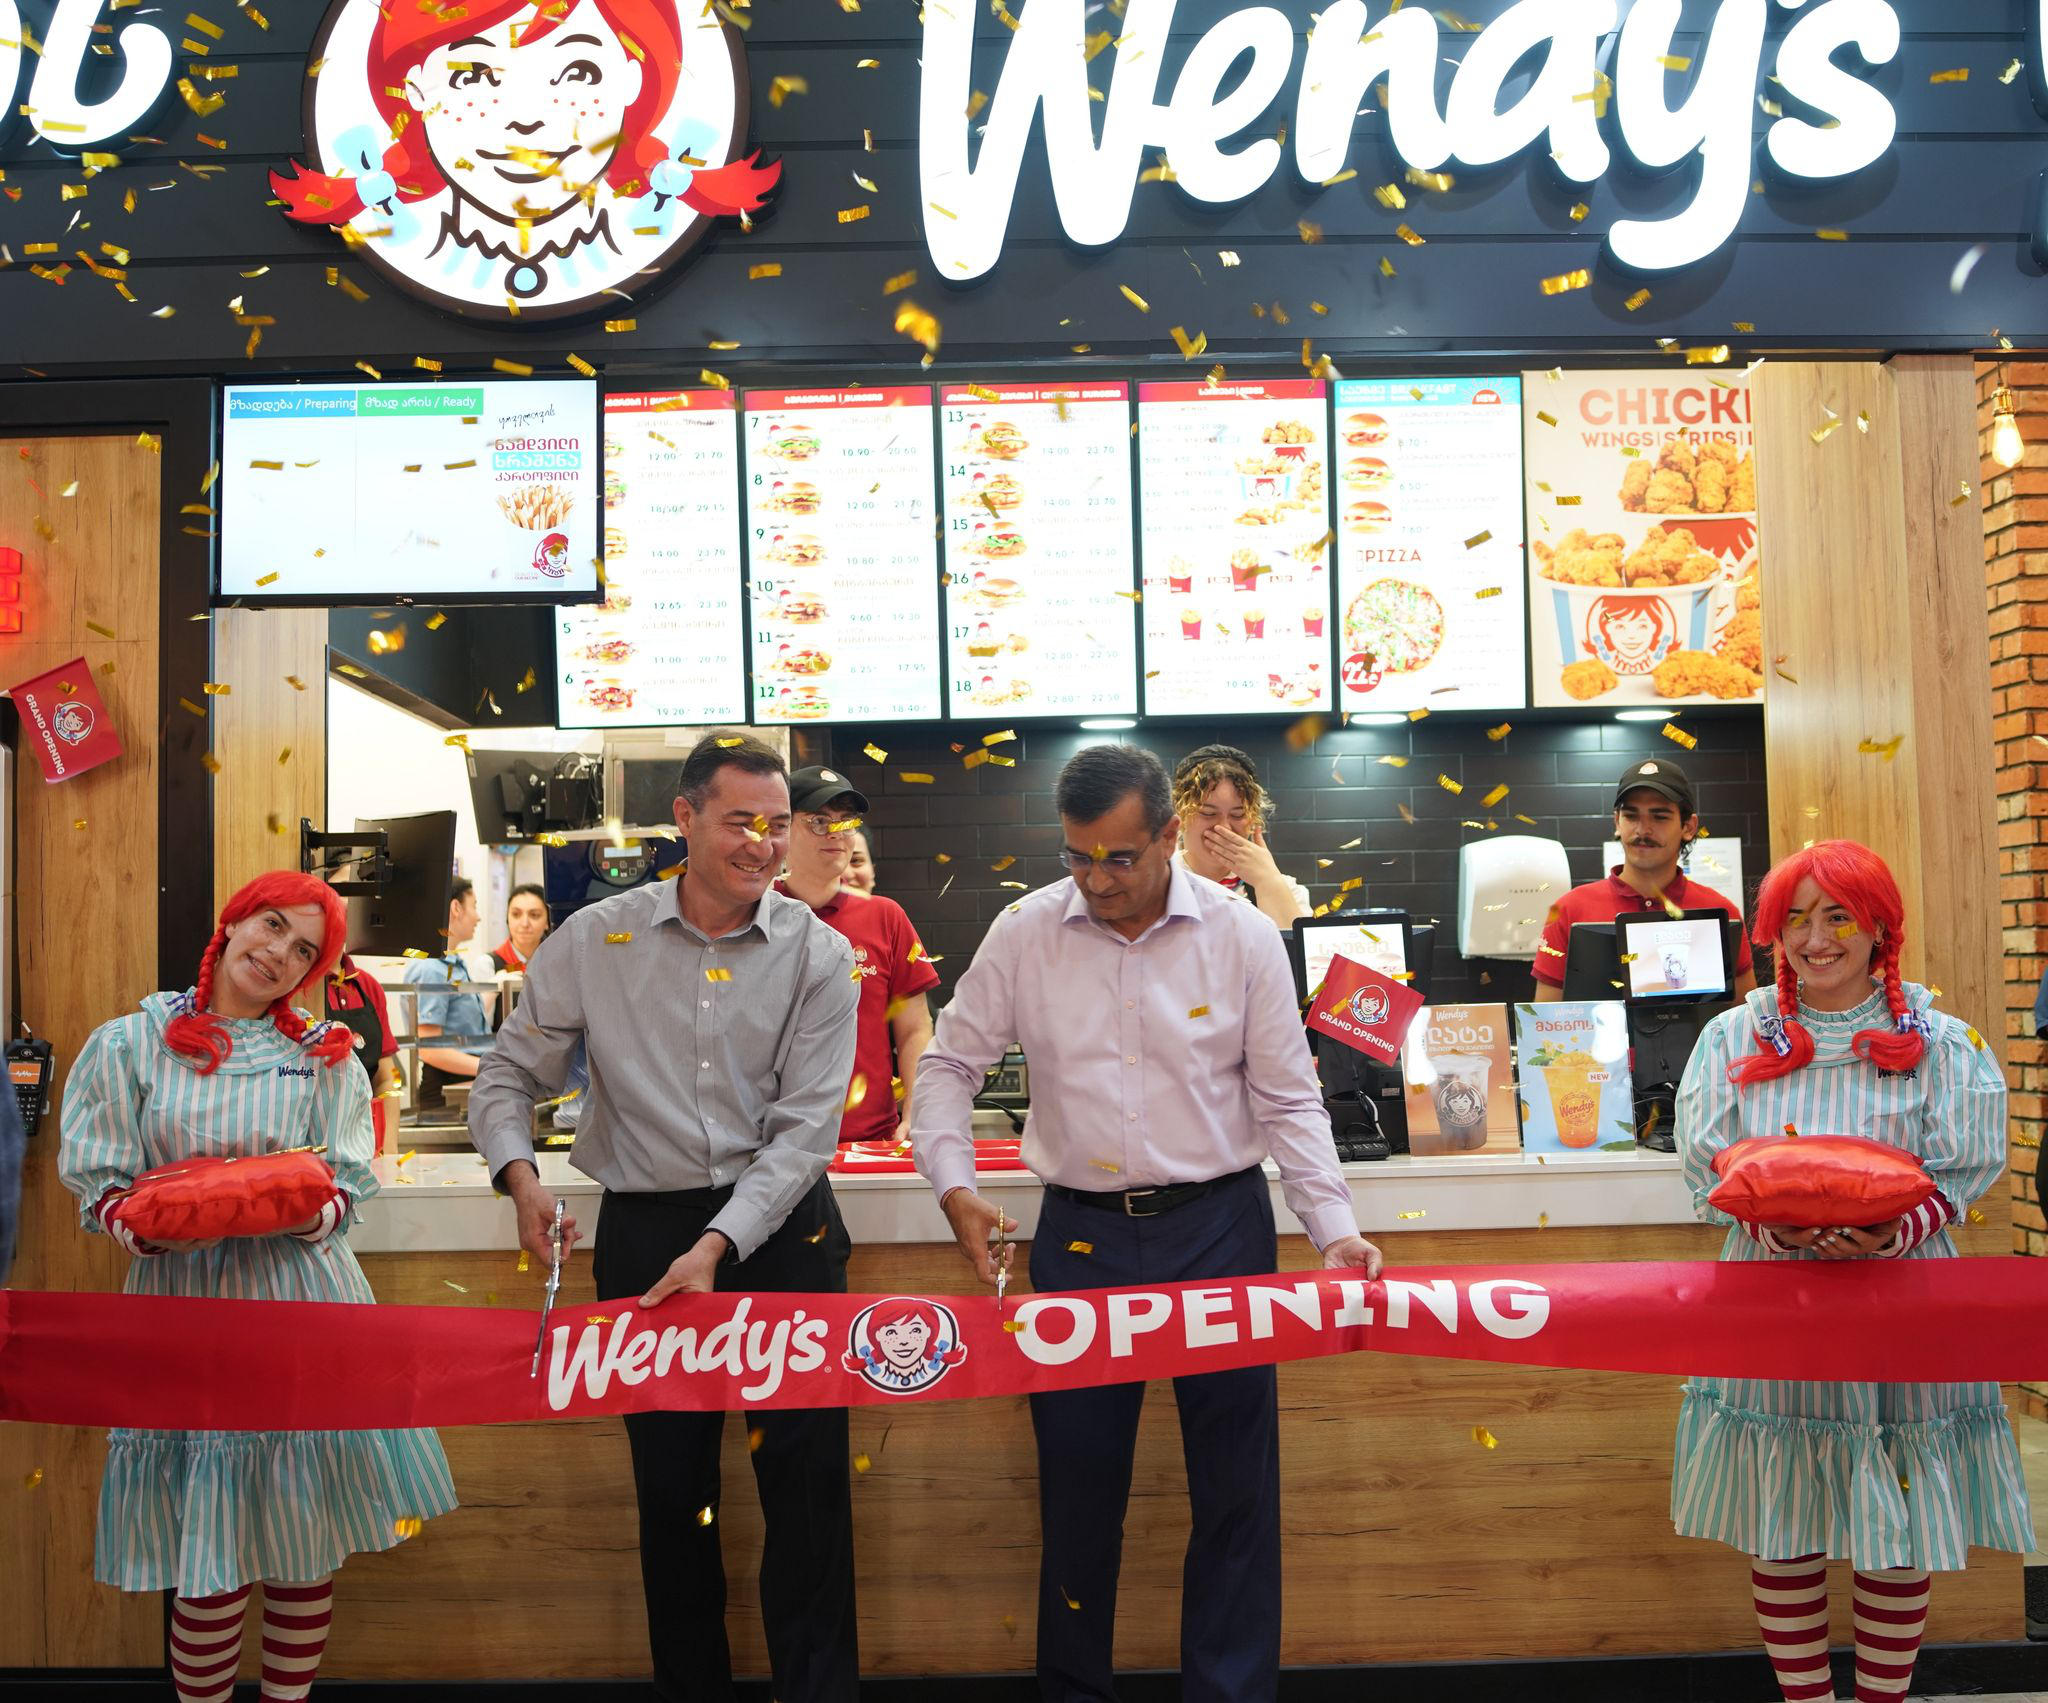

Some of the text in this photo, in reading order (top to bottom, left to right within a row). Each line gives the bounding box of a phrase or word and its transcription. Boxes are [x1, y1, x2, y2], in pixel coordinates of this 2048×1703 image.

[919, 0, 1900, 281] Wendys
[230, 399, 293, 412] მზადდება
[304, 397, 357, 411] Preparing
[365, 397, 398, 409] მზად
[401, 397, 432, 408] არის
[443, 396, 477, 409] Ready
[1579, 388, 1752, 425] CHICK
[752, 417, 759, 428] 7
[949, 411, 963, 422] 13
[1581, 431, 1737, 447] WINGS SRIPS
[950, 465, 965, 476] 14
[754, 474, 763, 486] 8
[952, 518, 968, 530] 15
[756, 528, 765, 539] 9
[1365, 549, 1422, 562] PIZZA
[953, 573, 969, 584] 16
[757, 580, 773, 592] 10
[563, 623, 572, 634] 5
[954, 627, 969, 638] 17
[759, 631, 771, 643] 11
[565, 673, 573, 684] 6
[760, 686, 775, 698] 12
[956, 680, 971, 692] 18
[26, 694, 66, 775] GRAND OPENING
[1319, 1011, 1395, 1053] GRAND OPENING
[279, 1066, 314, 1080] Wendy's
[1590, 1073, 1609, 1081] NEW
[1559, 1099, 1595, 1118] Wendy's
[547, 1279, 1550, 1411] Wendy's OPENING
